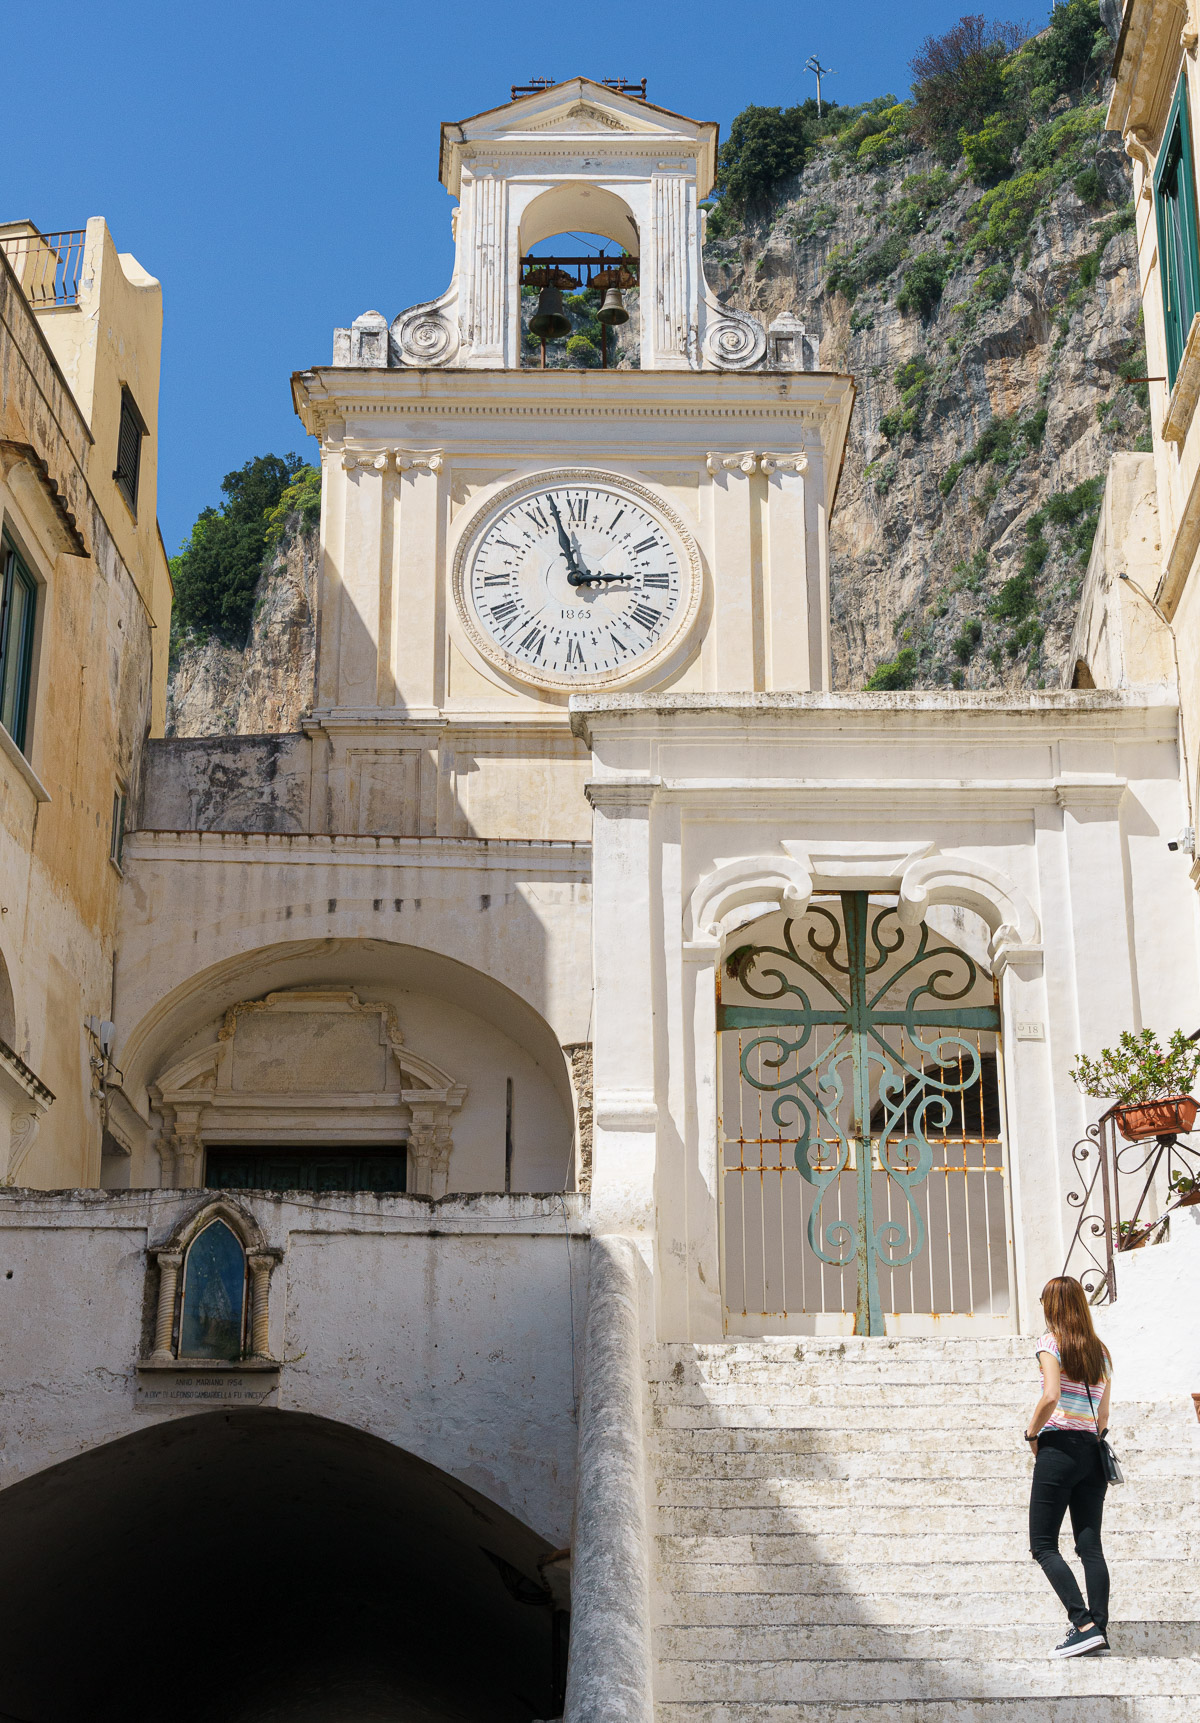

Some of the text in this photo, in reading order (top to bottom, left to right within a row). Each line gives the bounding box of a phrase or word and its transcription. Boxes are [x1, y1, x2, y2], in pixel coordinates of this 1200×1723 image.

[525, 506, 549, 531] XI
[566, 498, 589, 522] XII
[494, 534, 521, 553] X
[632, 535, 660, 555] II
[484, 571, 511, 587] IX
[643, 573, 670, 590] III
[490, 600, 521, 632] VIII
[561, 609, 592, 620] 1865
[630, 602, 663, 633] IIII
[520, 626, 547, 656] VII
[565, 638, 585, 664] VI
[609, 632, 628, 655] V
[175, 1378, 243, 1386] ANNO MARIANO 1954
